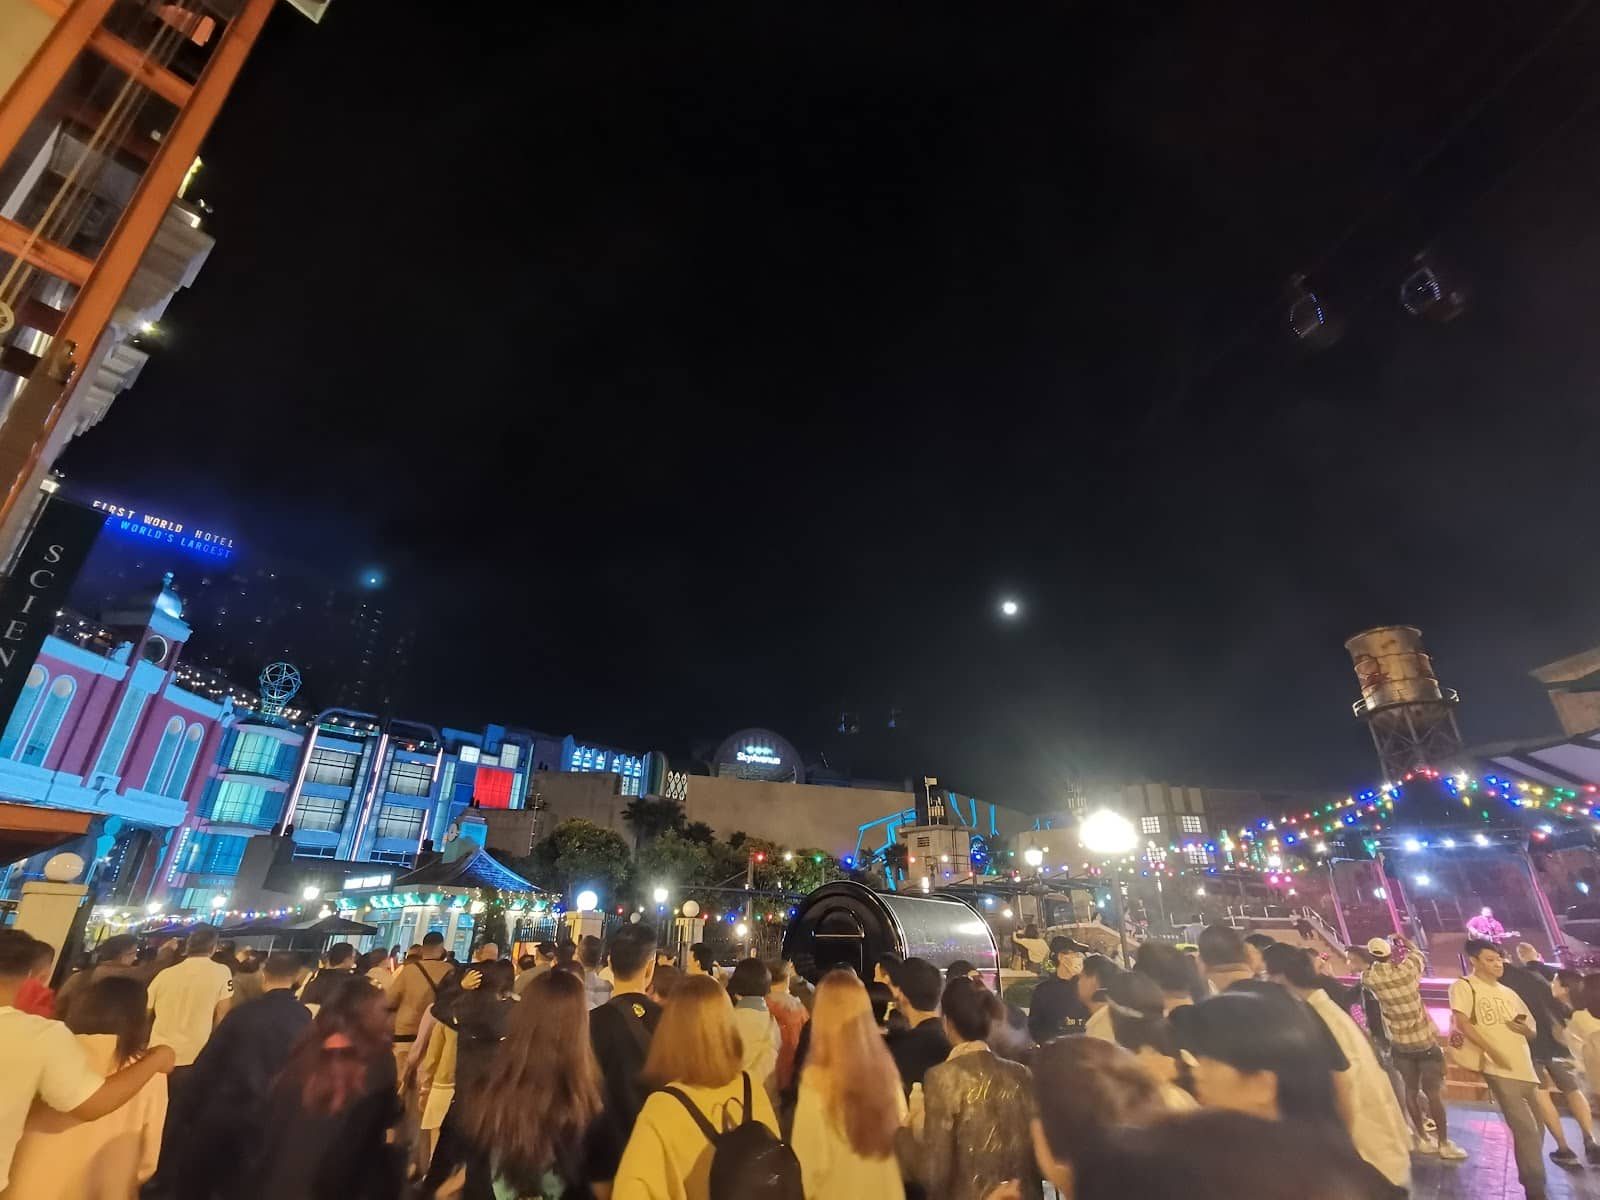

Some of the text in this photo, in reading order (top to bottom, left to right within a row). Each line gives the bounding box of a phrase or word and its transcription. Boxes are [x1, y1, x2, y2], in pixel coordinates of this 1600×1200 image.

[92, 500, 233, 548] FIRST WORLD HOTEL
[120, 520, 175, 543] WORLD'S
[180, 537, 232, 559] LARGEST
